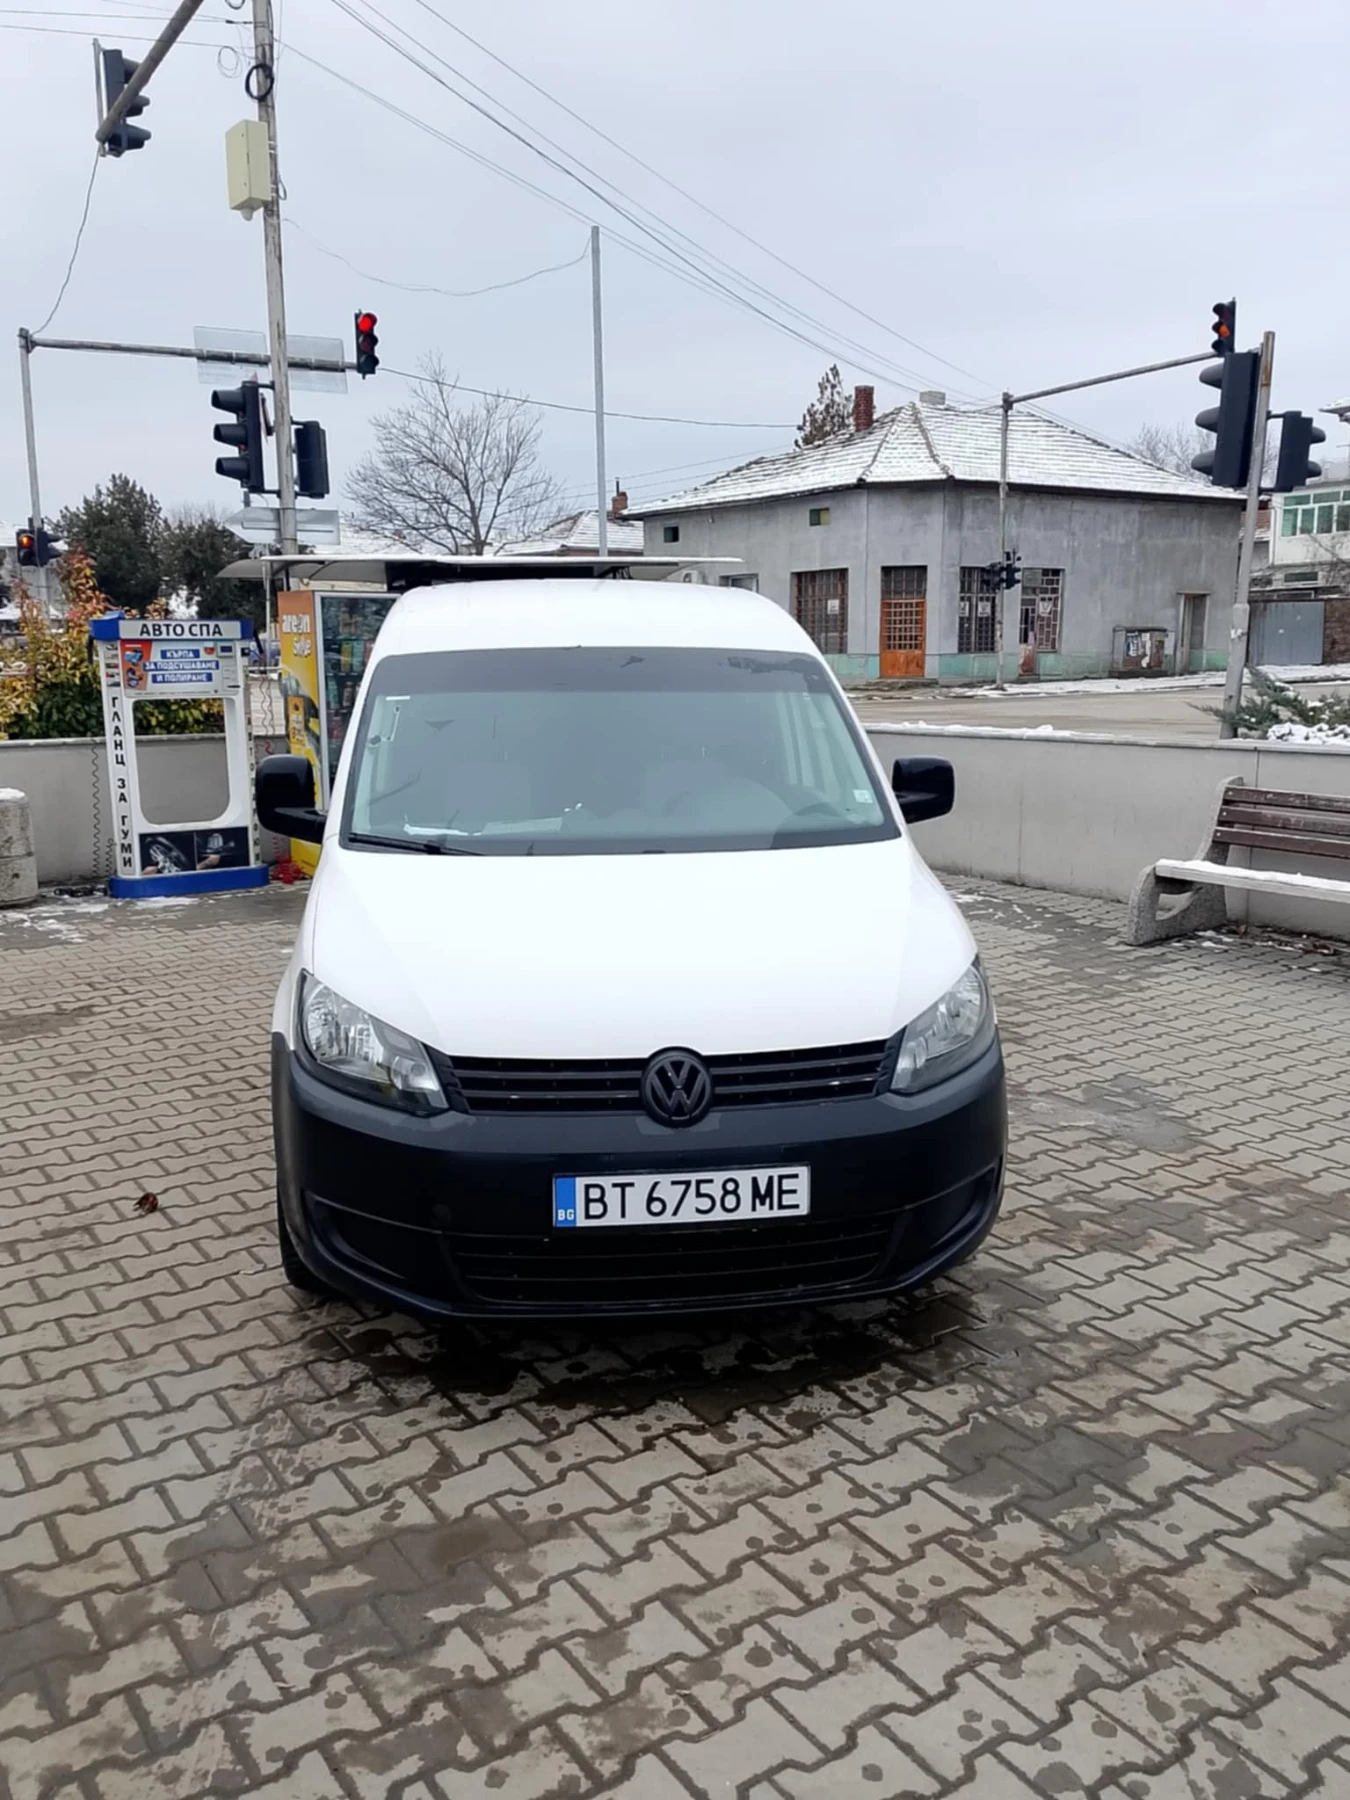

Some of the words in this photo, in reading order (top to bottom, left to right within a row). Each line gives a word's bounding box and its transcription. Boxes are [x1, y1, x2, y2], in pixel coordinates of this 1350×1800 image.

[139, 623, 185, 637] АВТО
[188, 623, 223, 637] СПА
[112, 696, 126, 767] ГЛАНЦ
[117, 778, 128, 803] ЗА
[120, 815, 133, 868] ГУМИ
[583, 1181, 636, 1220] BT
[645, 1177, 742, 1217] 6758
[751, 1173, 800, 1213] ME
[557, 1209, 575, 1221] BG
